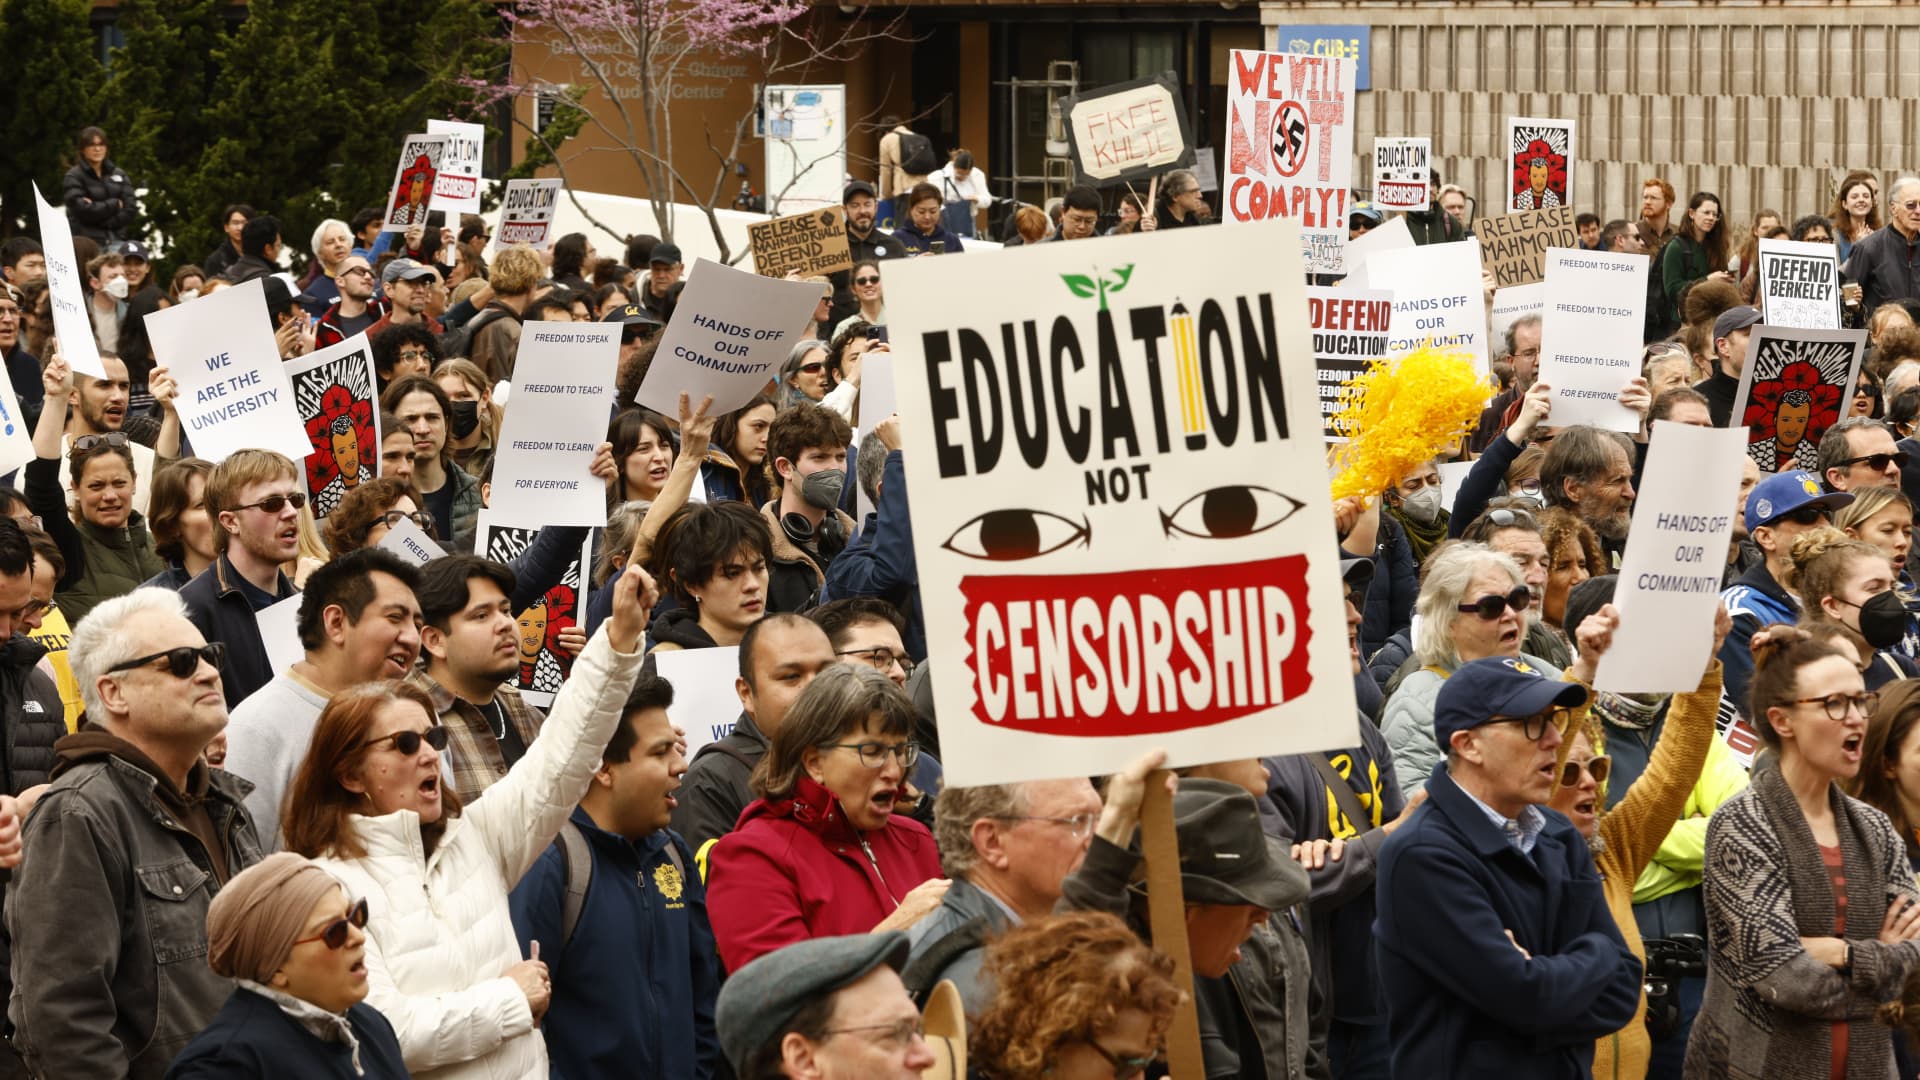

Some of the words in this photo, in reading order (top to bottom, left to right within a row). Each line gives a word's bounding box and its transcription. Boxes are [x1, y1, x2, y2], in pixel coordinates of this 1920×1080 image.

[1235, 50, 1283, 100] WE
[1289, 56, 1344, 101] WILL
[671, 83, 727, 99] Center
[1377, 146, 1426, 168] EDUCATION
[507, 187, 556, 208] EDUCATION
[1230, 177, 1346, 228] COMPLY!
[1379, 184, 1424, 205] CENSORSHIP
[751, 214, 817, 244] RELEASE
[1482, 206, 1572, 238] RELEASE
[753, 232, 809, 255] MAHMOUD
[810, 225, 845, 241] KHALIL
[1482, 229, 1575, 262] MAHMOUD
[756, 242, 823, 270] DEFEND
[810, 250, 850, 272] FREEDOM
[1560, 259, 1598, 269] FREEDOM
[1599, 262, 1610, 270] TO
[1611, 264, 1635, 272] SPEAK
[1768, 258, 1832, 283] DEFEND
[1770, 280, 1832, 301] BERKELEY
[625, 306, 640, 316] Cal
[1442, 296, 1467, 309] OFF
[1556, 304, 1594, 314] FREEDOM
[1597, 306, 1606, 315] TO
[1608, 308, 1632, 317] TEACH
[1308, 298, 1391, 332] DEFEND
[1416, 317, 1444, 330] OUR
[693, 314, 751, 338] HANDS
[754, 330, 784, 340] OFF
[535, 333, 574, 343] FREEDOM
[576, 334, 586, 343] TO
[586, 335, 609, 343] SPEAK
[714, 341, 748, 356] OUR
[205, 352, 232, 372] WE
[674, 346, 772, 374] COMMUNITY
[1555, 354, 1592, 364] FREEDOM
[1594, 358, 1604, 366] TO
[1606, 359, 1630, 368] LEARN
[197, 382, 227, 404] ARE
[228, 370, 261, 392] THE
[524, 384, 564, 394] FREEDOM
[566, 386, 576, 394] TO
[578, 386, 603, 394] TEACH
[922, 292, 1289, 479] EDUCATION
[1560, 389, 1576, 398] FOR
[1577, 390, 1617, 401] EVERYONE
[190, 388, 279, 430] UNIVERSITY
[513, 441, 552, 450] FREEDOM
[555, 442, 565, 450] TO
[567, 443, 594, 452] LEARN
[515, 480, 532, 488] FOR
[534, 480, 579, 490] EVERYONE
[1084, 464, 1152, 506] NOT
[1657, 513, 1708, 532] HANDS
[1709, 516, 1728, 532] OFF
[1675, 546, 1704, 562] OUR
[1638, 574, 1720, 592] COMMUNITY
[975, 585, 1297, 722] CENSORSHIP
